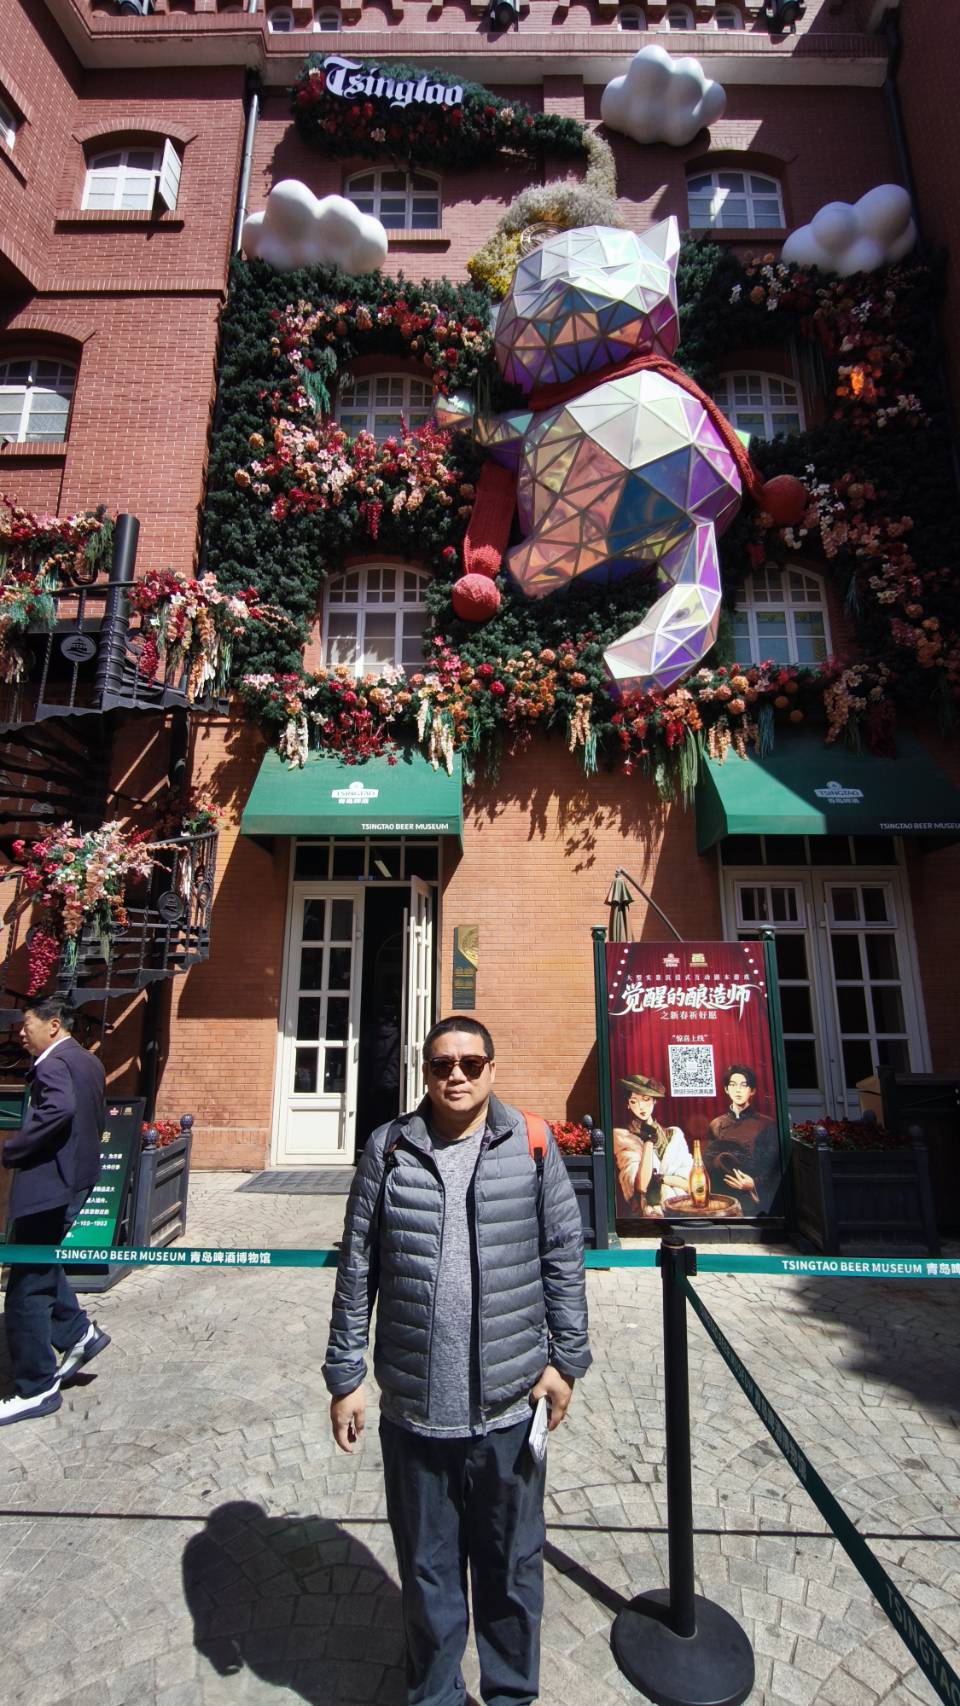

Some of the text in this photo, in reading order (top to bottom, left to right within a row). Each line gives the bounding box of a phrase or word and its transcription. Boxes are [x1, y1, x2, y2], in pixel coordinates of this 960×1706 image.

[323, 56, 464, 108] Tsingtao
[609, 982, 762, 1022] 觉醒的酿造师
[55, 1249, 271, 1264] TSINGTAO BEER MUSEUM 青岛啤酒博物馆
[782, 1260, 838, 1271] TSINGTAO
[840, 1262, 870, 1272] BEER
[872, 1263, 922, 1274] MUSEUM
